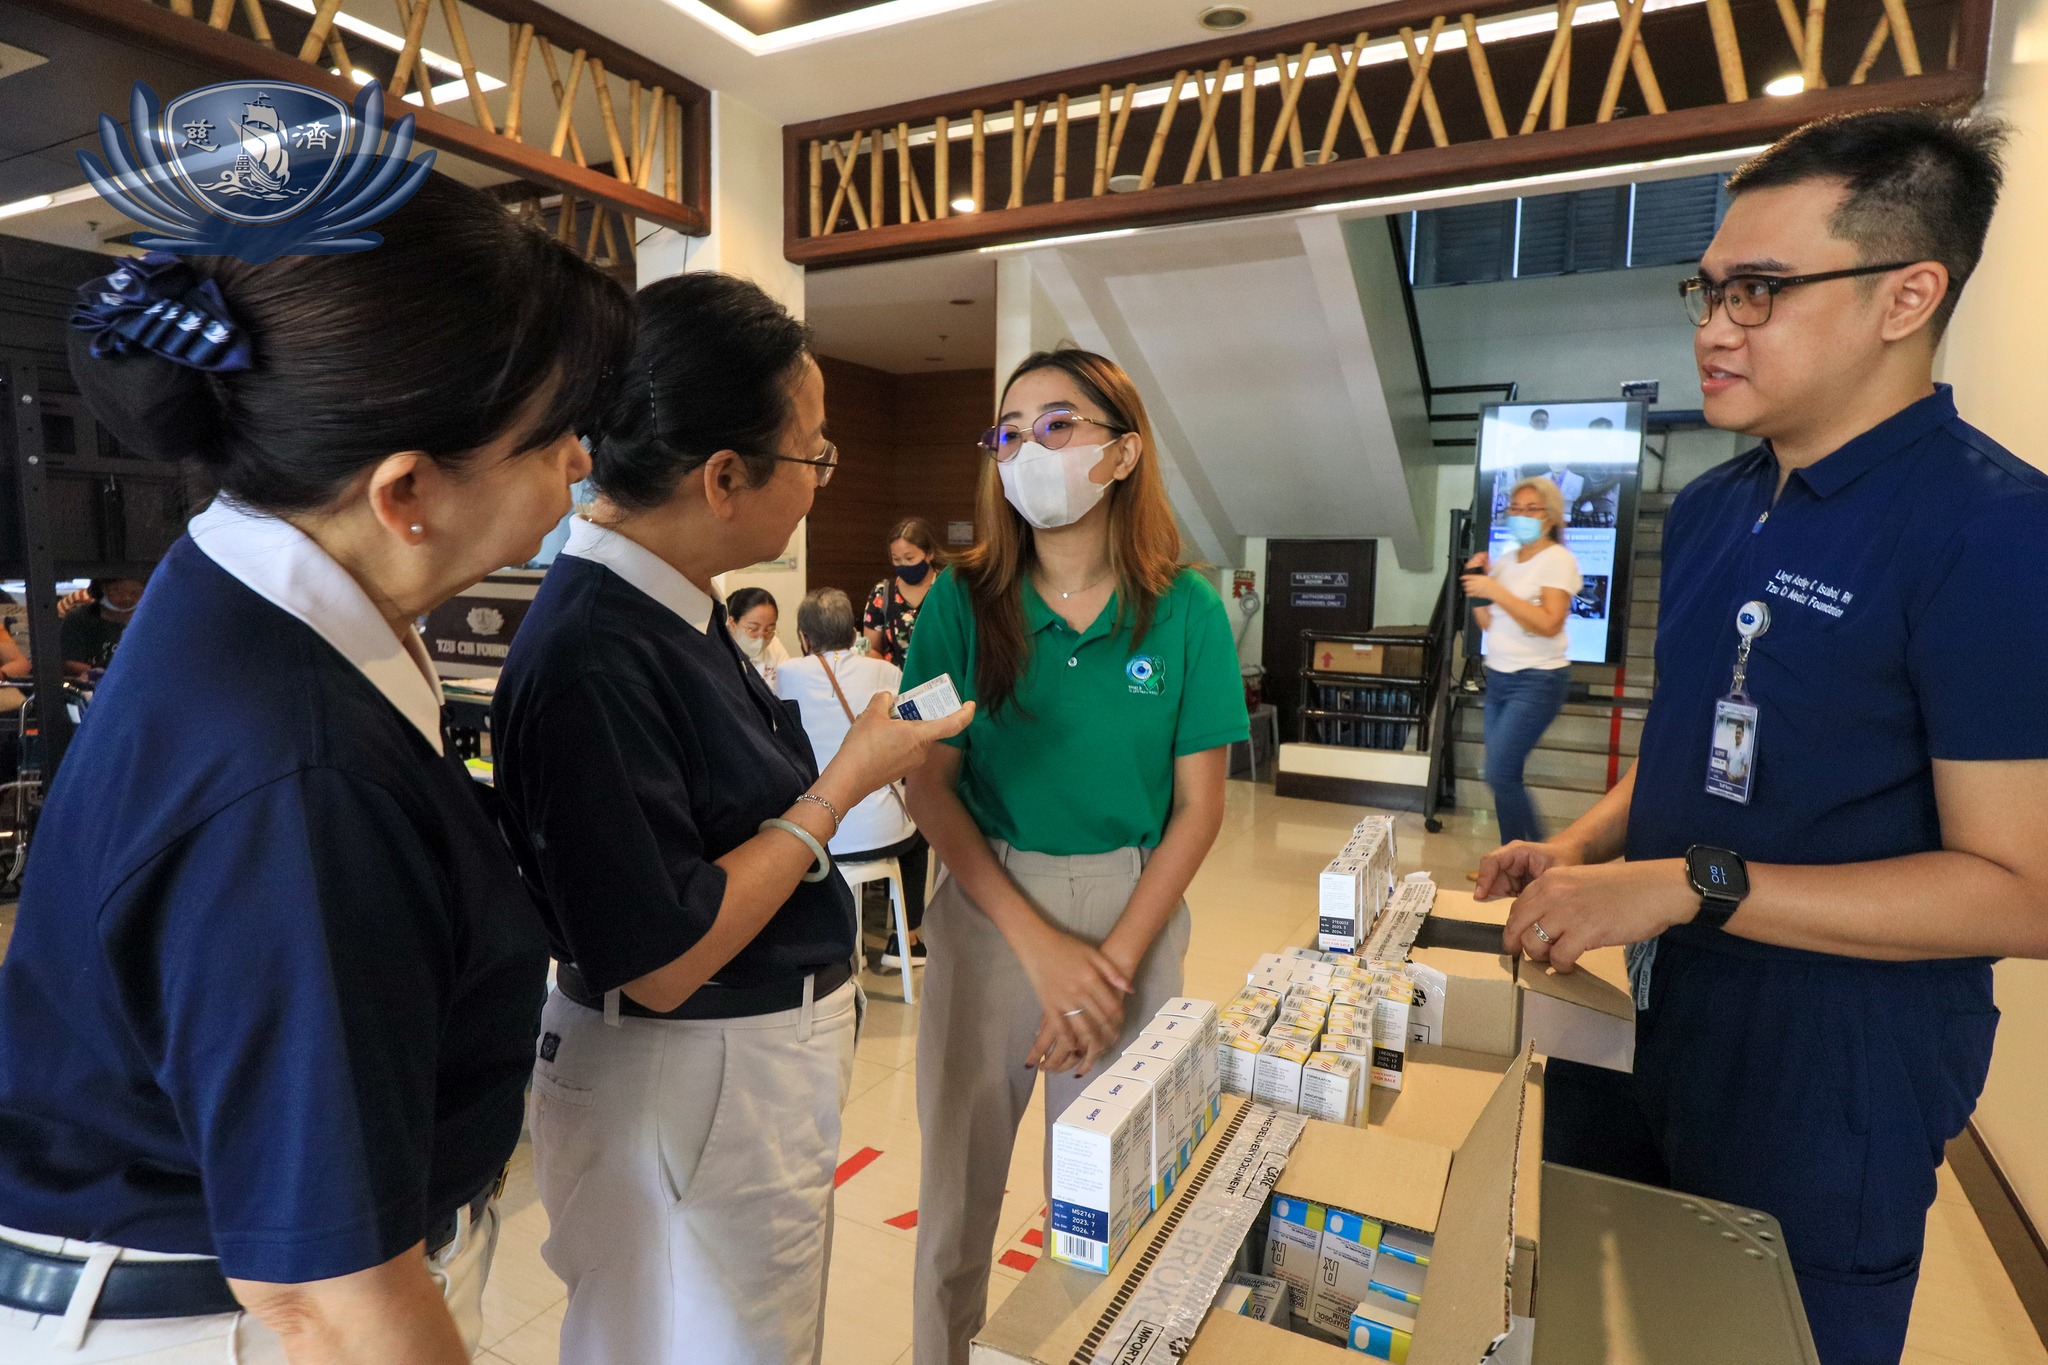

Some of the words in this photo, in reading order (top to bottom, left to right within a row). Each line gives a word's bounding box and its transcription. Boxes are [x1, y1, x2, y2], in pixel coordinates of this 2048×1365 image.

[1765, 580, 1780, 595] Tzu
[436, 639, 456, 654] TZU
[457, 641, 476, 656] CHI
[1248, 1126, 1270, 1159] DELIVERY
[1072, 1208, 1095, 1219] MS2767
[1317, 1312, 1350, 1331] QUAFOSOL
